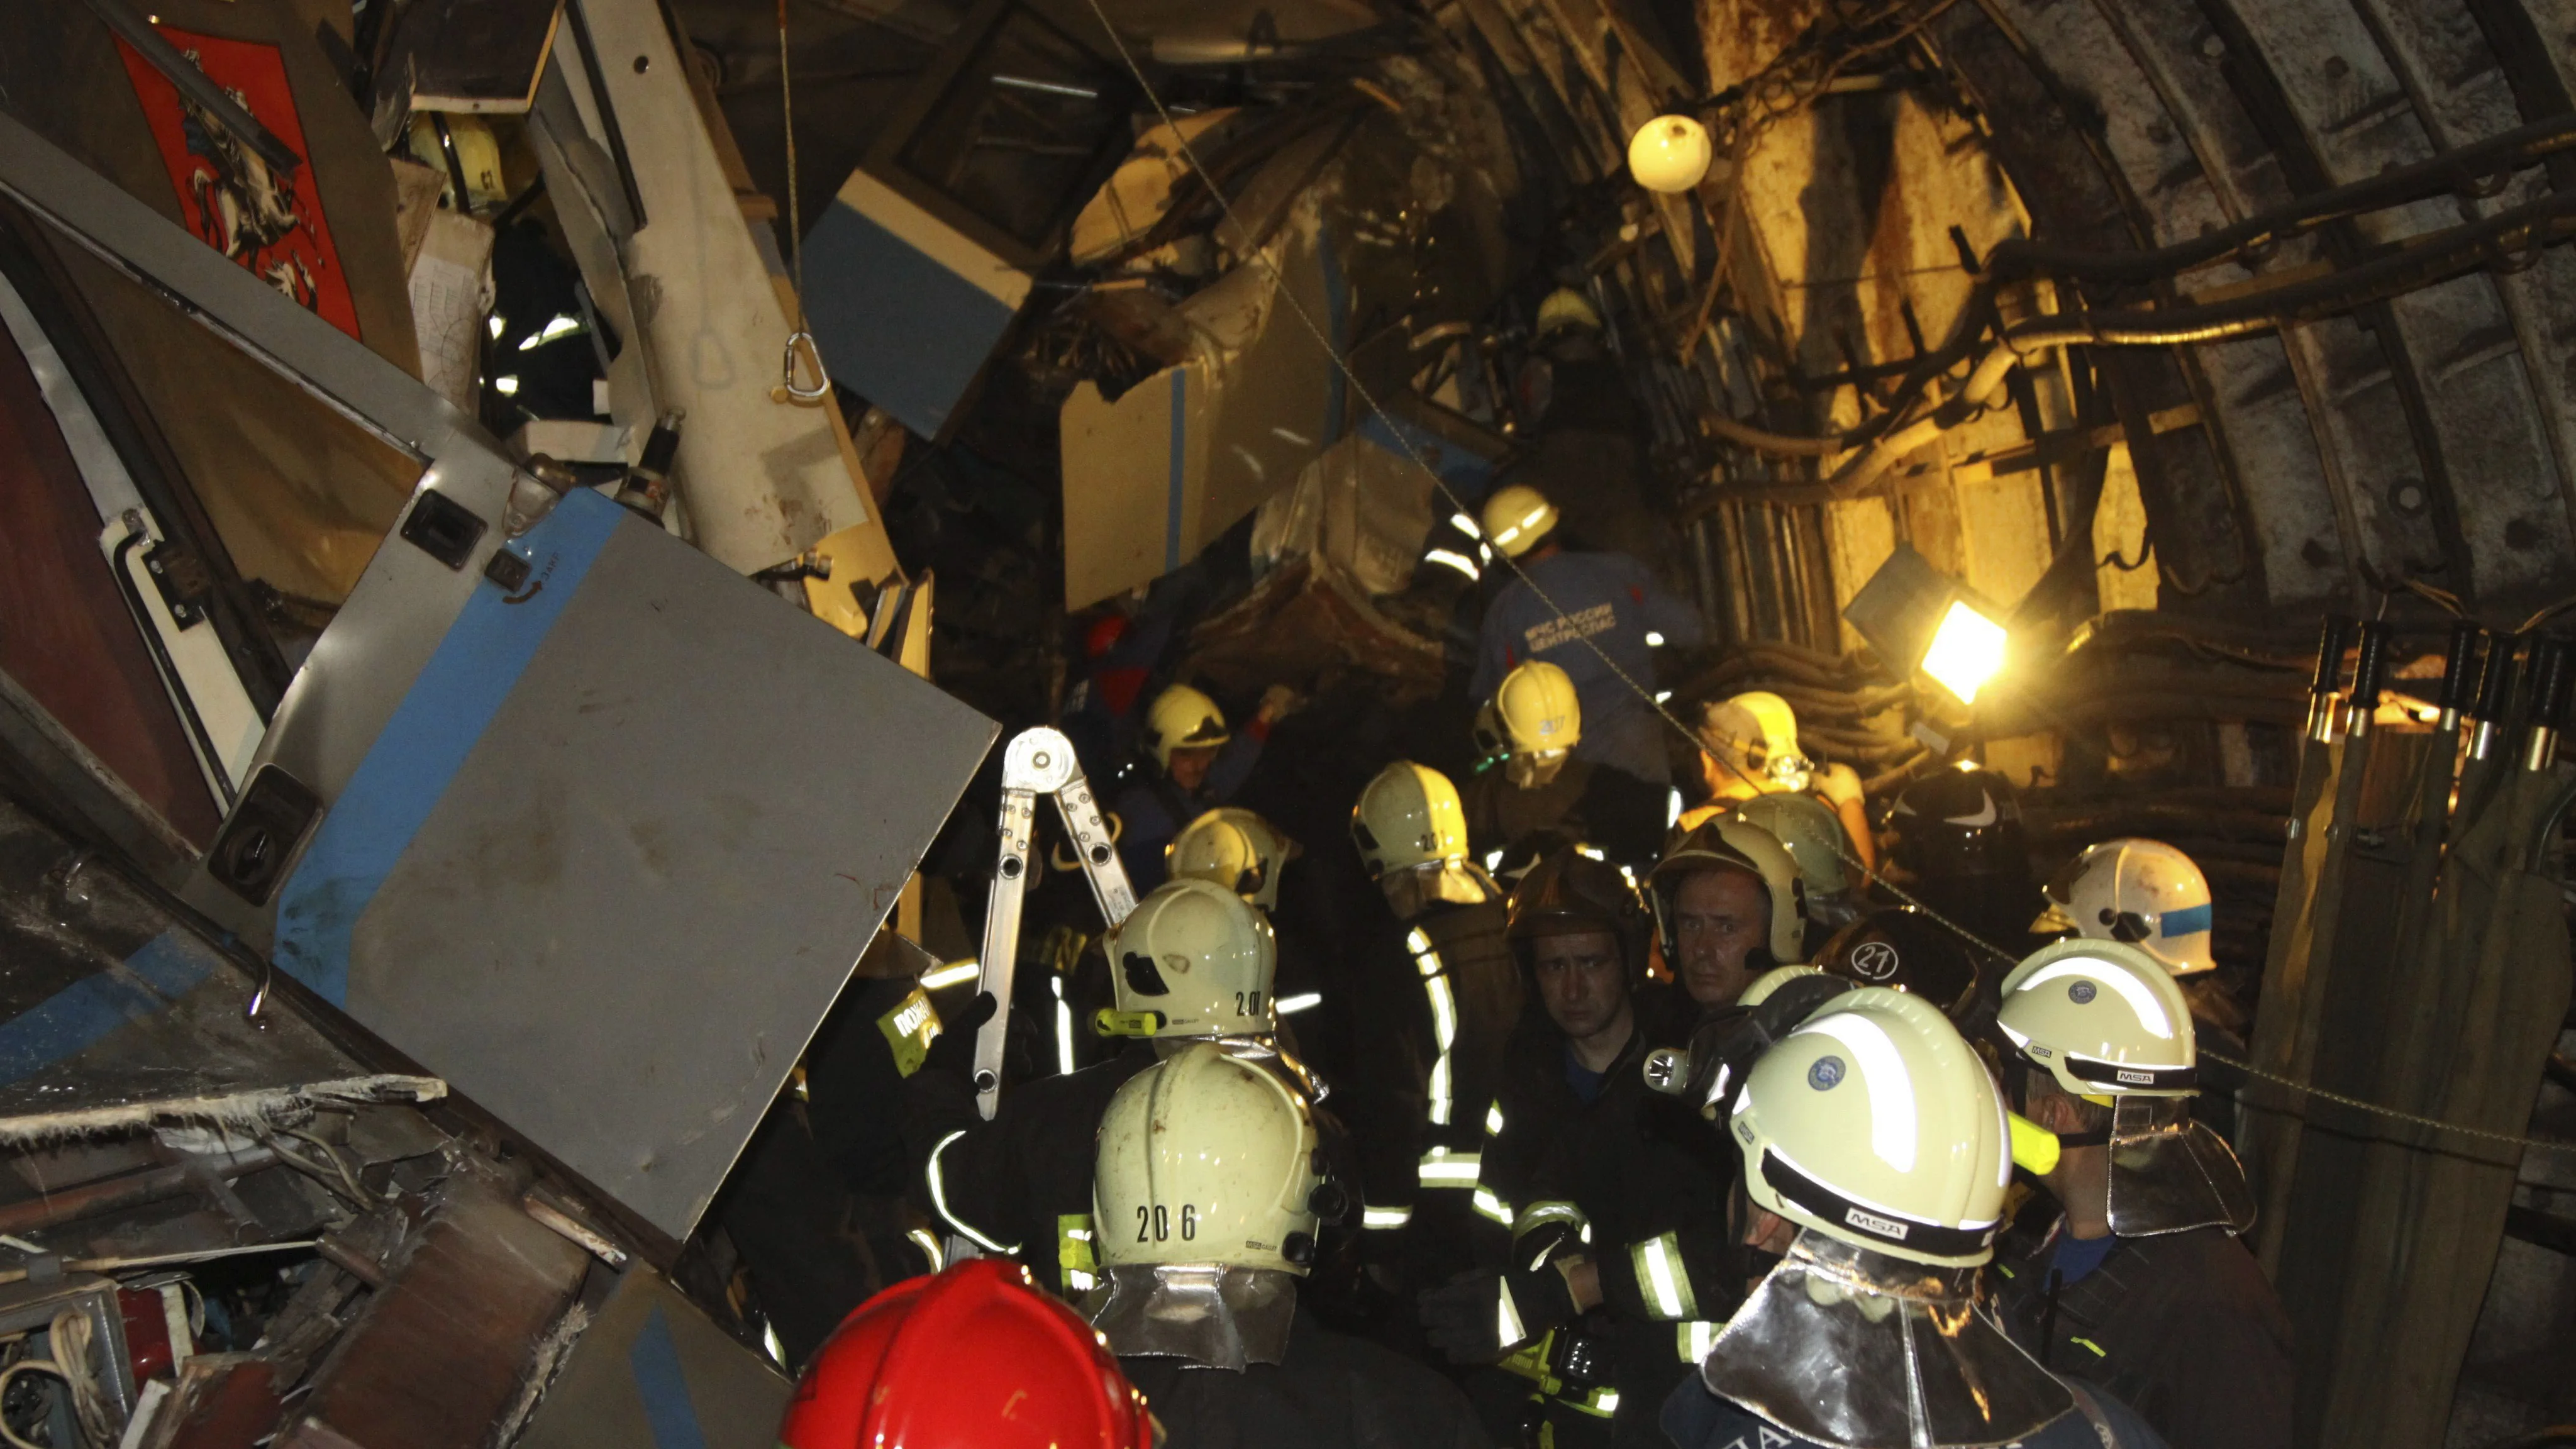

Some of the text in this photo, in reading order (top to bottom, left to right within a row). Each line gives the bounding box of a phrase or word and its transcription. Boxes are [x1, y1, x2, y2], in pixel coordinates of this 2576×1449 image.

[2032, 1046, 2051, 1058] MSA
[2119, 1073, 2153, 1082] MSA
[1136, 1204, 1196, 1243] 206
[1850, 1213, 1902, 1236] MSA
